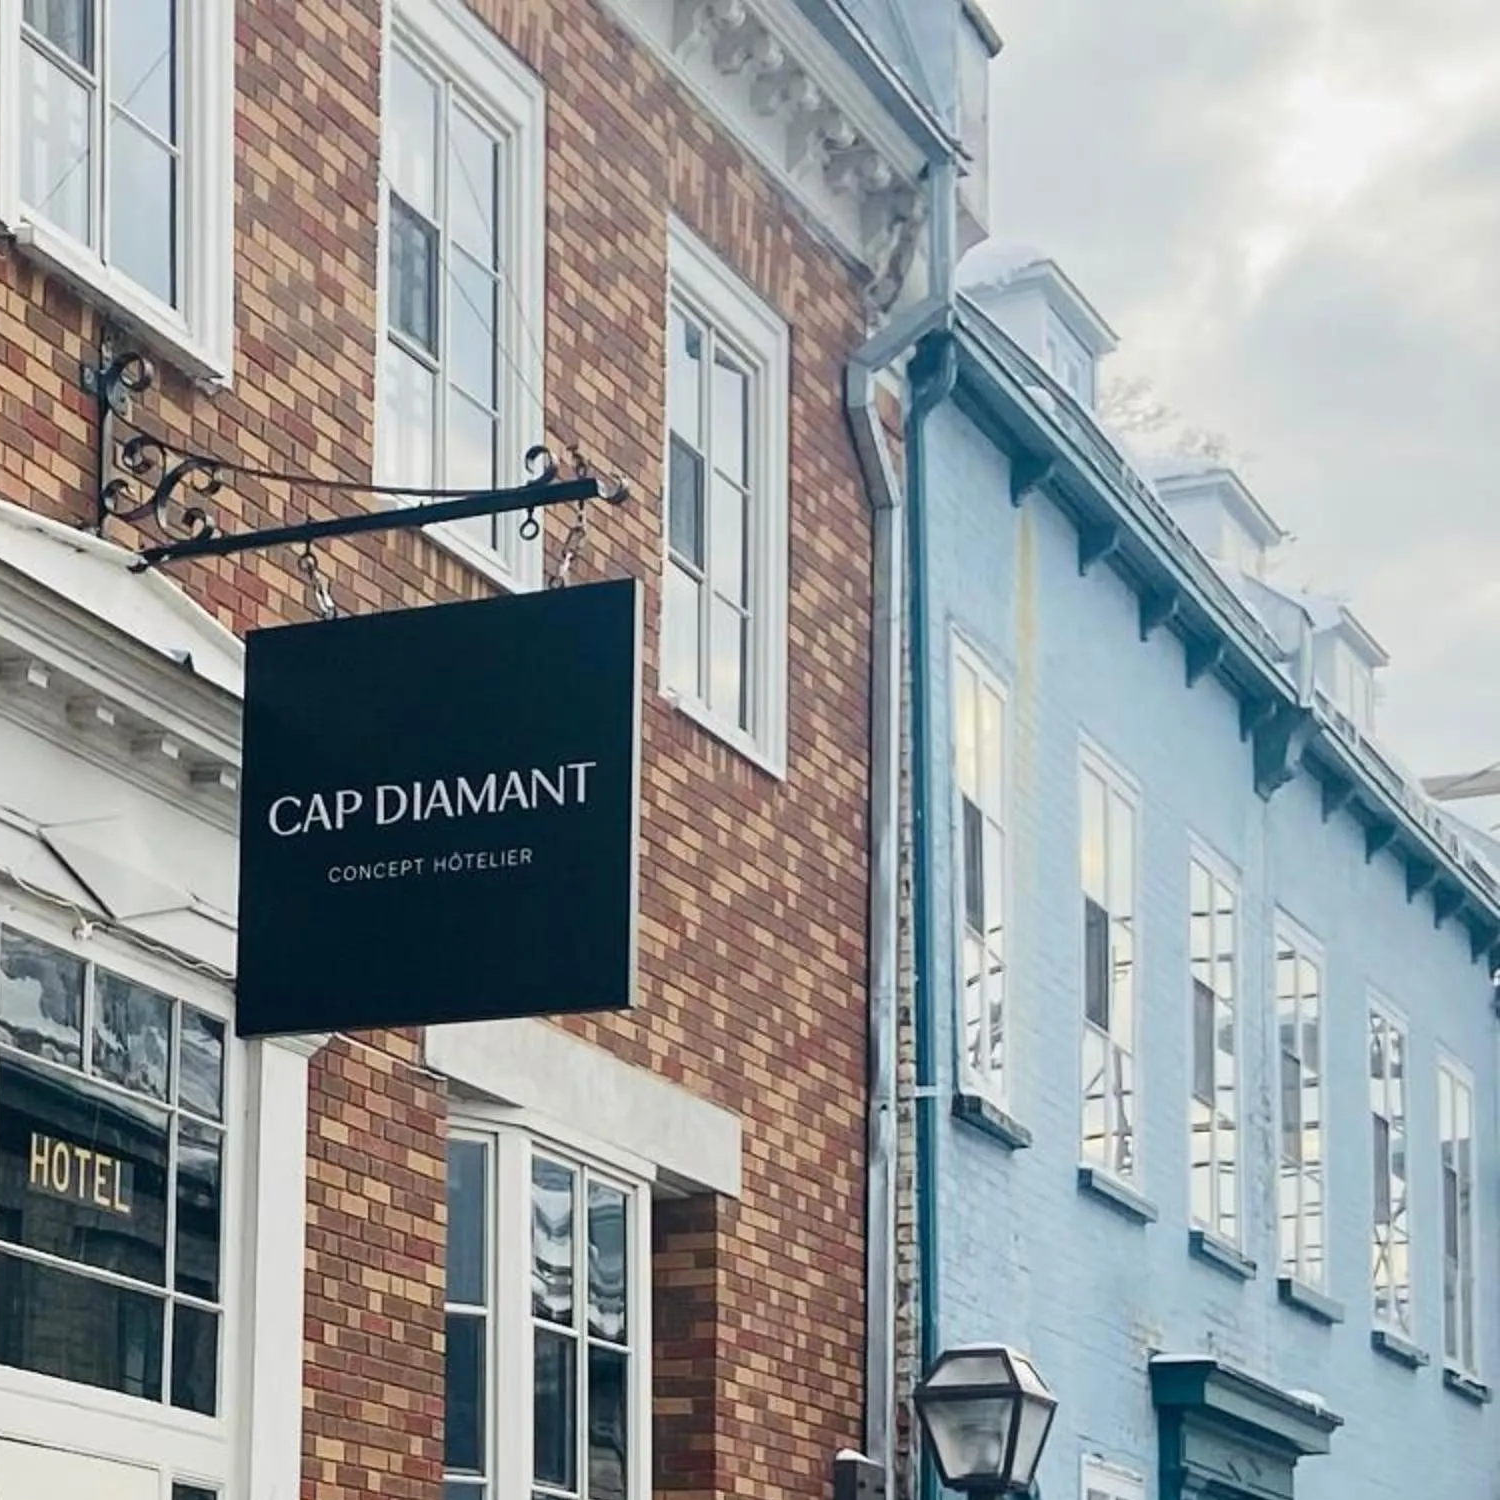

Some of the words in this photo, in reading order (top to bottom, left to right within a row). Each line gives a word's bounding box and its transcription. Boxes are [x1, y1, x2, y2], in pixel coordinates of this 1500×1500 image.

[268, 788, 363, 837] CAP
[375, 761, 597, 826] DIAMANT
[328, 857, 426, 883] CONCEPT
[433, 847, 534, 874] HÔTELIER
[30, 1131, 132, 1214] HOTEL
